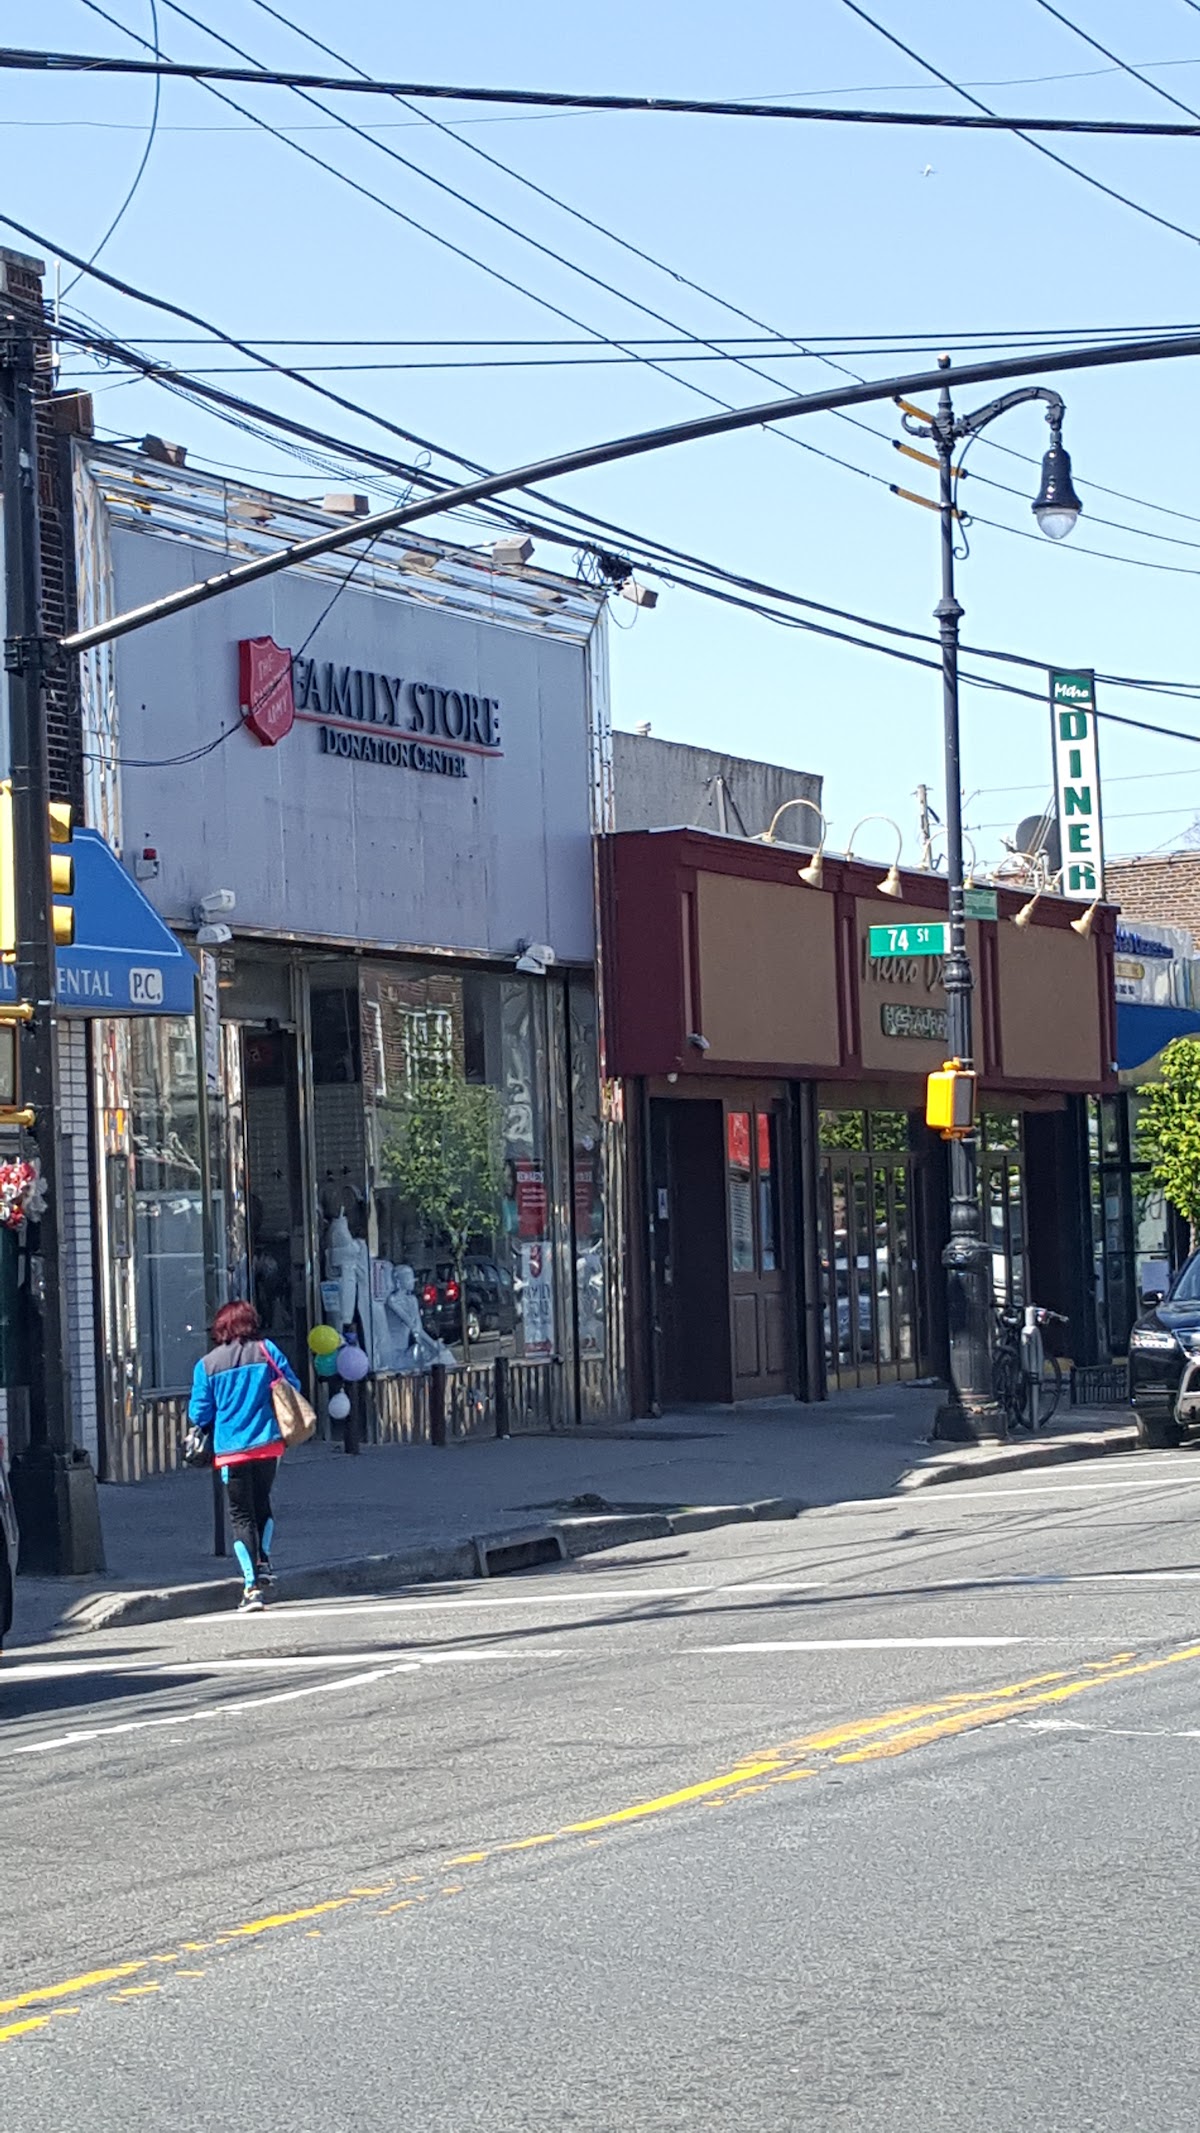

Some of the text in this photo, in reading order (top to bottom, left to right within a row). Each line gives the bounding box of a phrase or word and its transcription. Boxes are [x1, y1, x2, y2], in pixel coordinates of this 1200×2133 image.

[293, 656, 404, 727] FAMILY
[409, 681, 501, 747] STORE
[320, 726, 467, 778] DONATION CENTER
[1059, 711, 1097, 891] DINER
[887, 928, 929, 951] 74 St
[56, 967, 161, 1000] ENTAL P.C.
